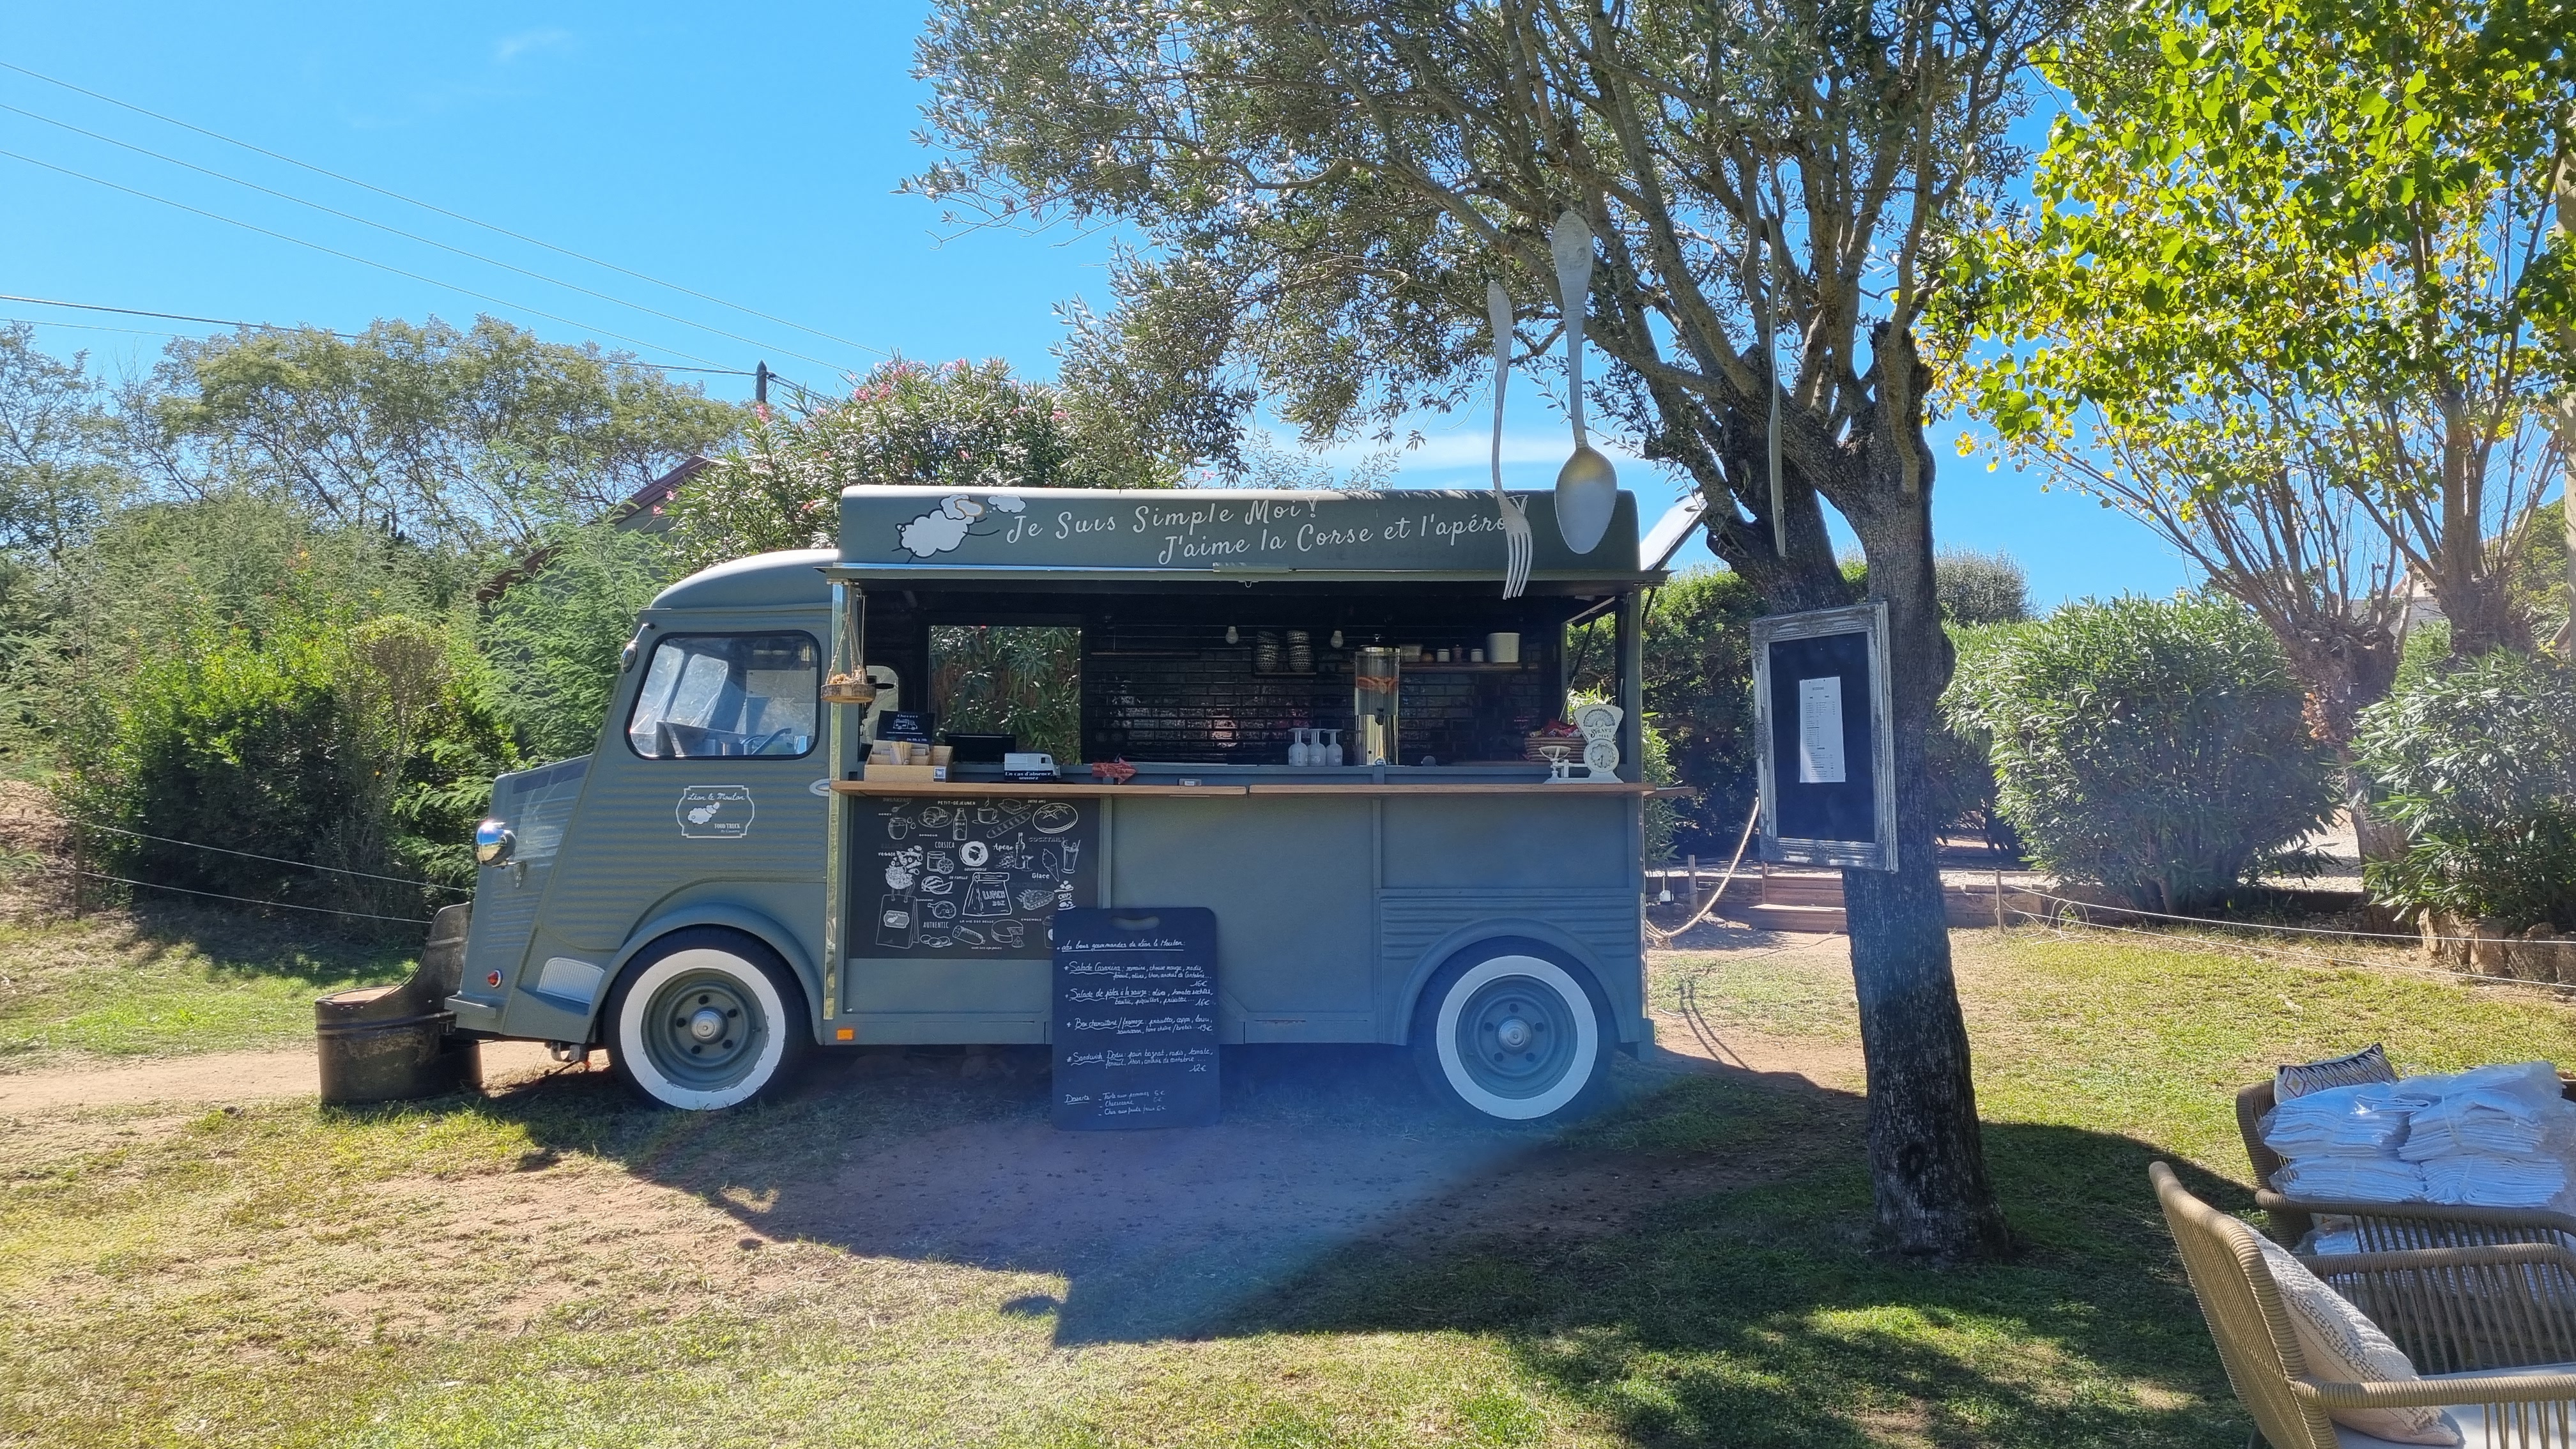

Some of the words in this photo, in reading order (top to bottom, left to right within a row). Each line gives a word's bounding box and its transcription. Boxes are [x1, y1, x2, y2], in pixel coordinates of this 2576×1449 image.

[1006, 516, 1043, 544] Je
[1055, 511, 1116, 539] Suis
[1133, 503, 1234, 535] Simple
[1158, 535, 1250, 565] J'aime
[1261, 529, 1286, 551] la
[1297, 523, 1374, 552] Corse
[1384, 518, 1411, 540] et
[982, 890, 1006, 900] LUNCH
[1069, 961, 1092, 972] Salade
[1070, 988, 1094, 999] Salade
[1096, 988, 1103, 997] de
[1195, 998, 1210, 1006] 16€
[1073, 1052, 1103, 1062] Sandwich
